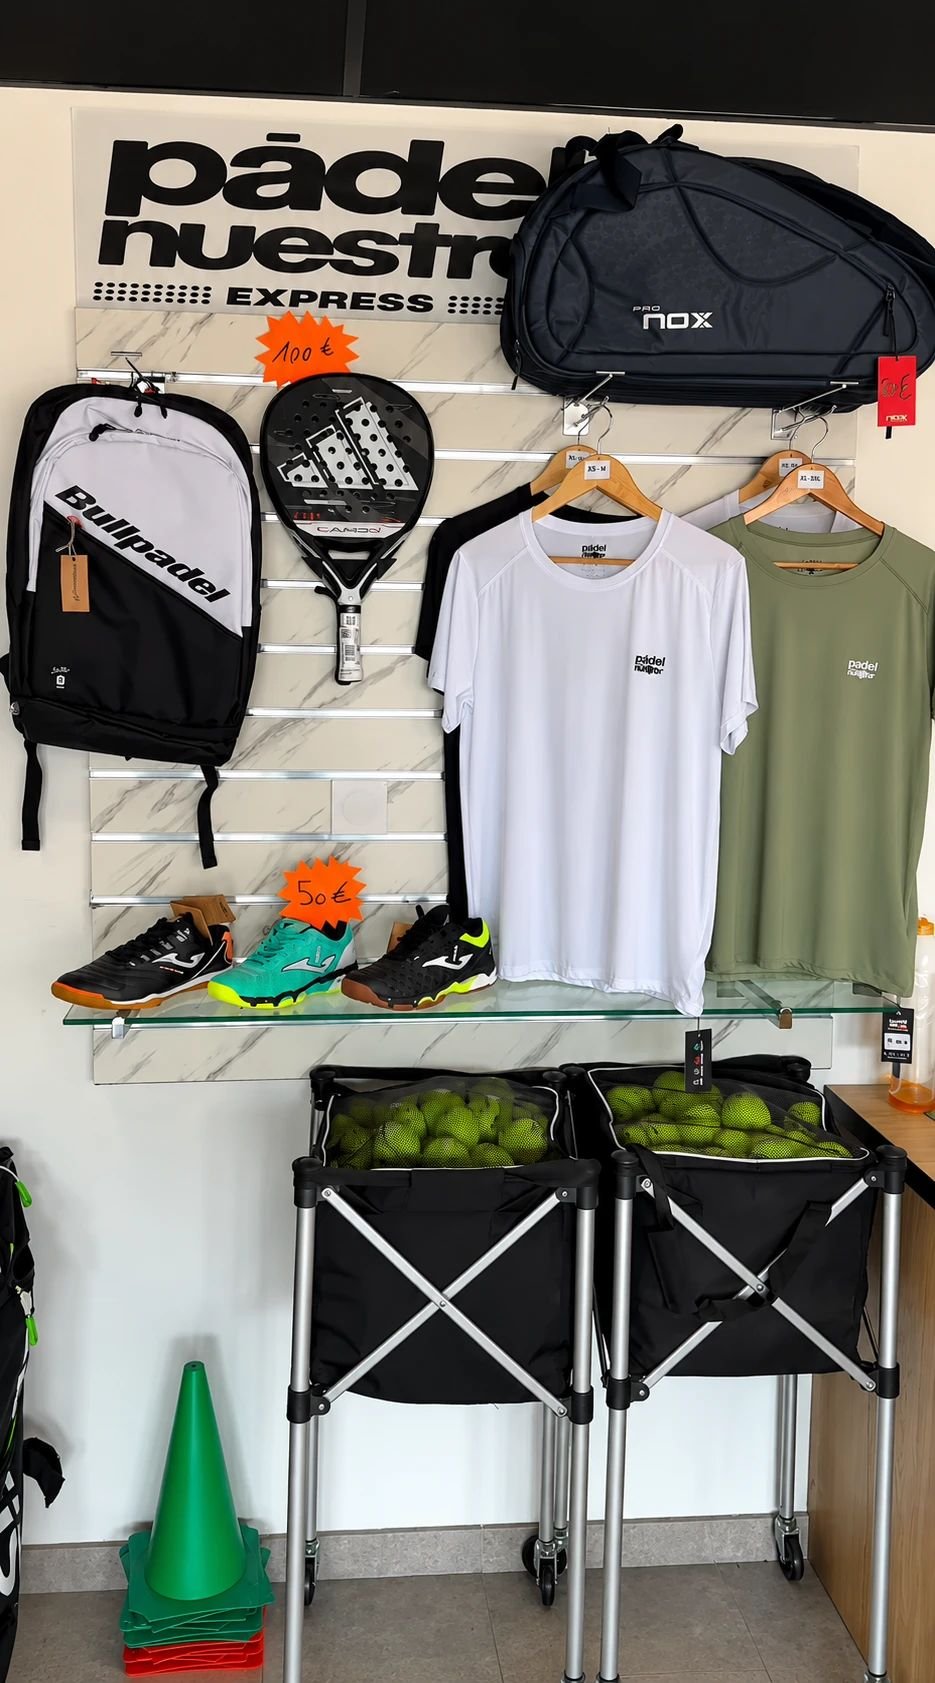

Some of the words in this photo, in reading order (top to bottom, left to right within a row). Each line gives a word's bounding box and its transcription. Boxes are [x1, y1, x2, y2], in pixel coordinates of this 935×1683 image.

[226, 287, 434, 313] EXPRESS
[272, 340, 312, 364] 100
[320, 336, 334, 357] €
[55, 485, 231, 603] Bullpadel
